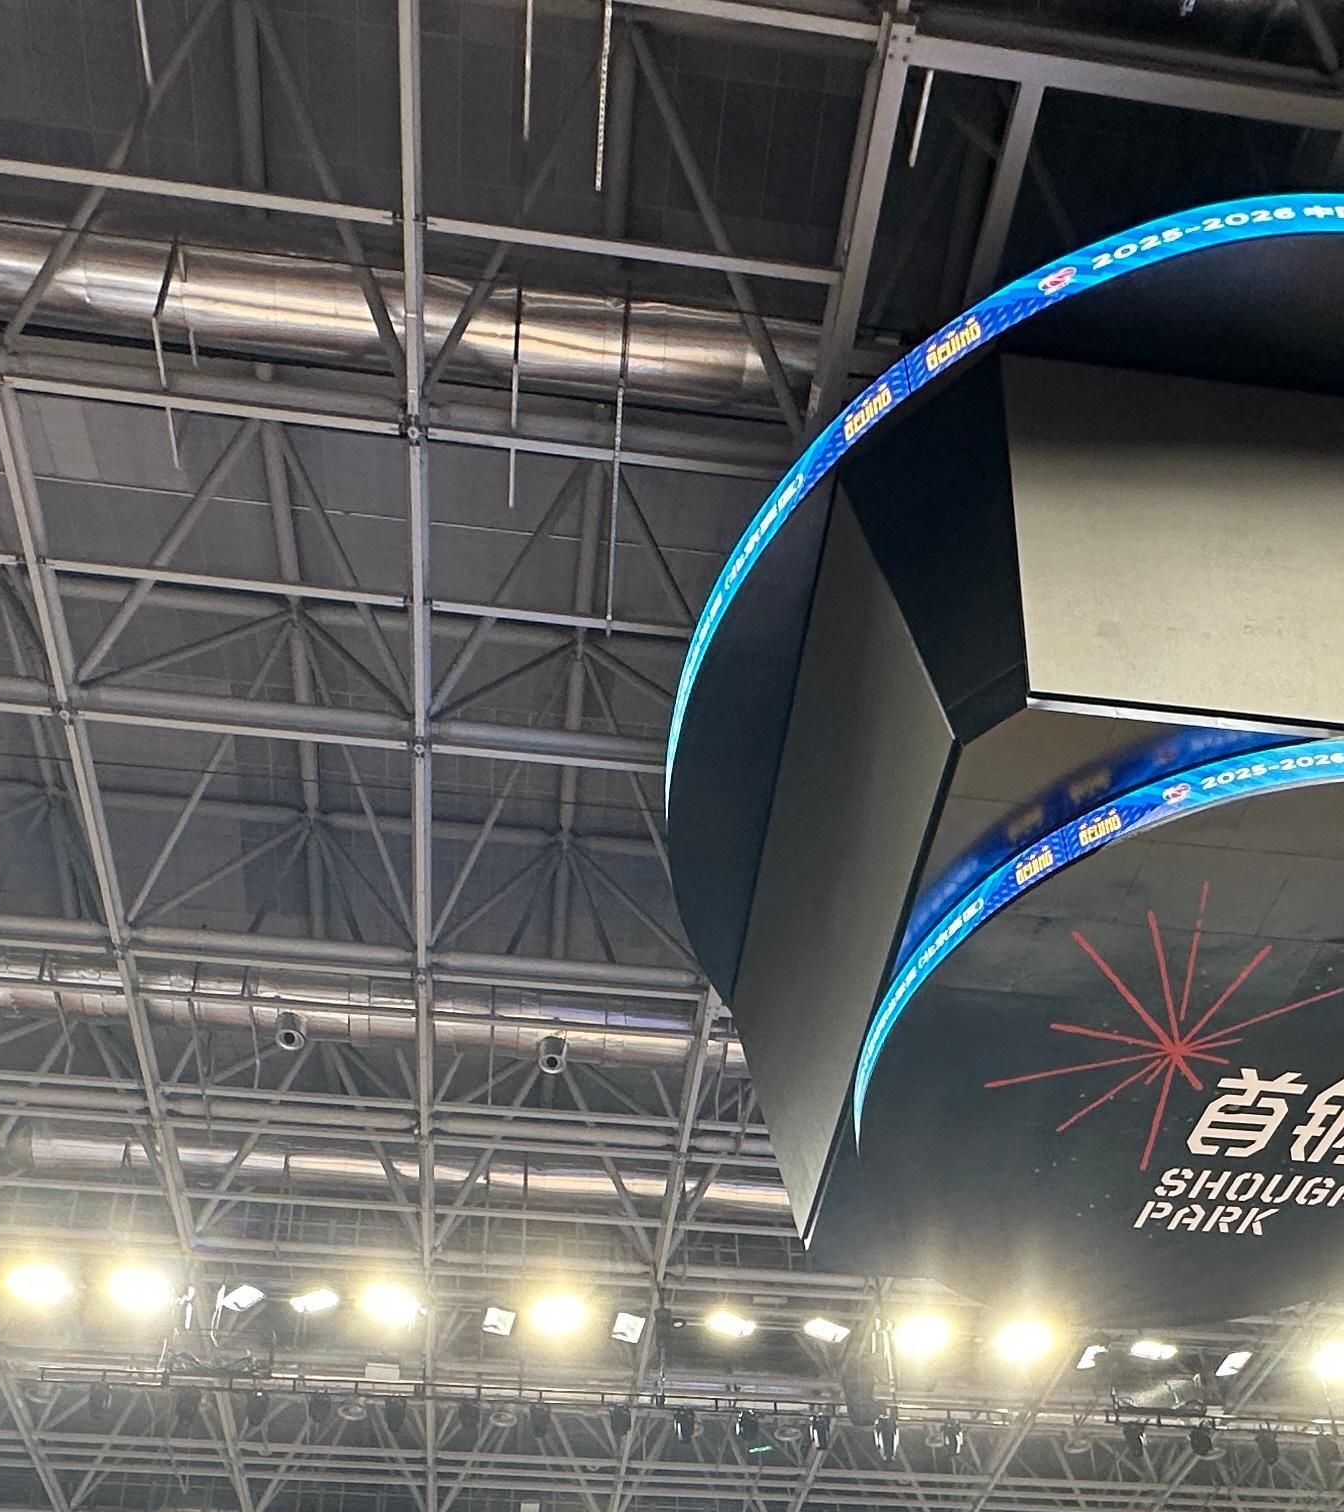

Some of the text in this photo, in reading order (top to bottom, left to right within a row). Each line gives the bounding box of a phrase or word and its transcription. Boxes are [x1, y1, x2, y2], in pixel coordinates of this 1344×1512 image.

[1091, 206, 1297, 270] 2025-2026
[1079, 814, 1122, 847] BEIJING
[1016, 848, 1054, 886] BEIJING
[1133, 1200, 1281, 1236] PARK
